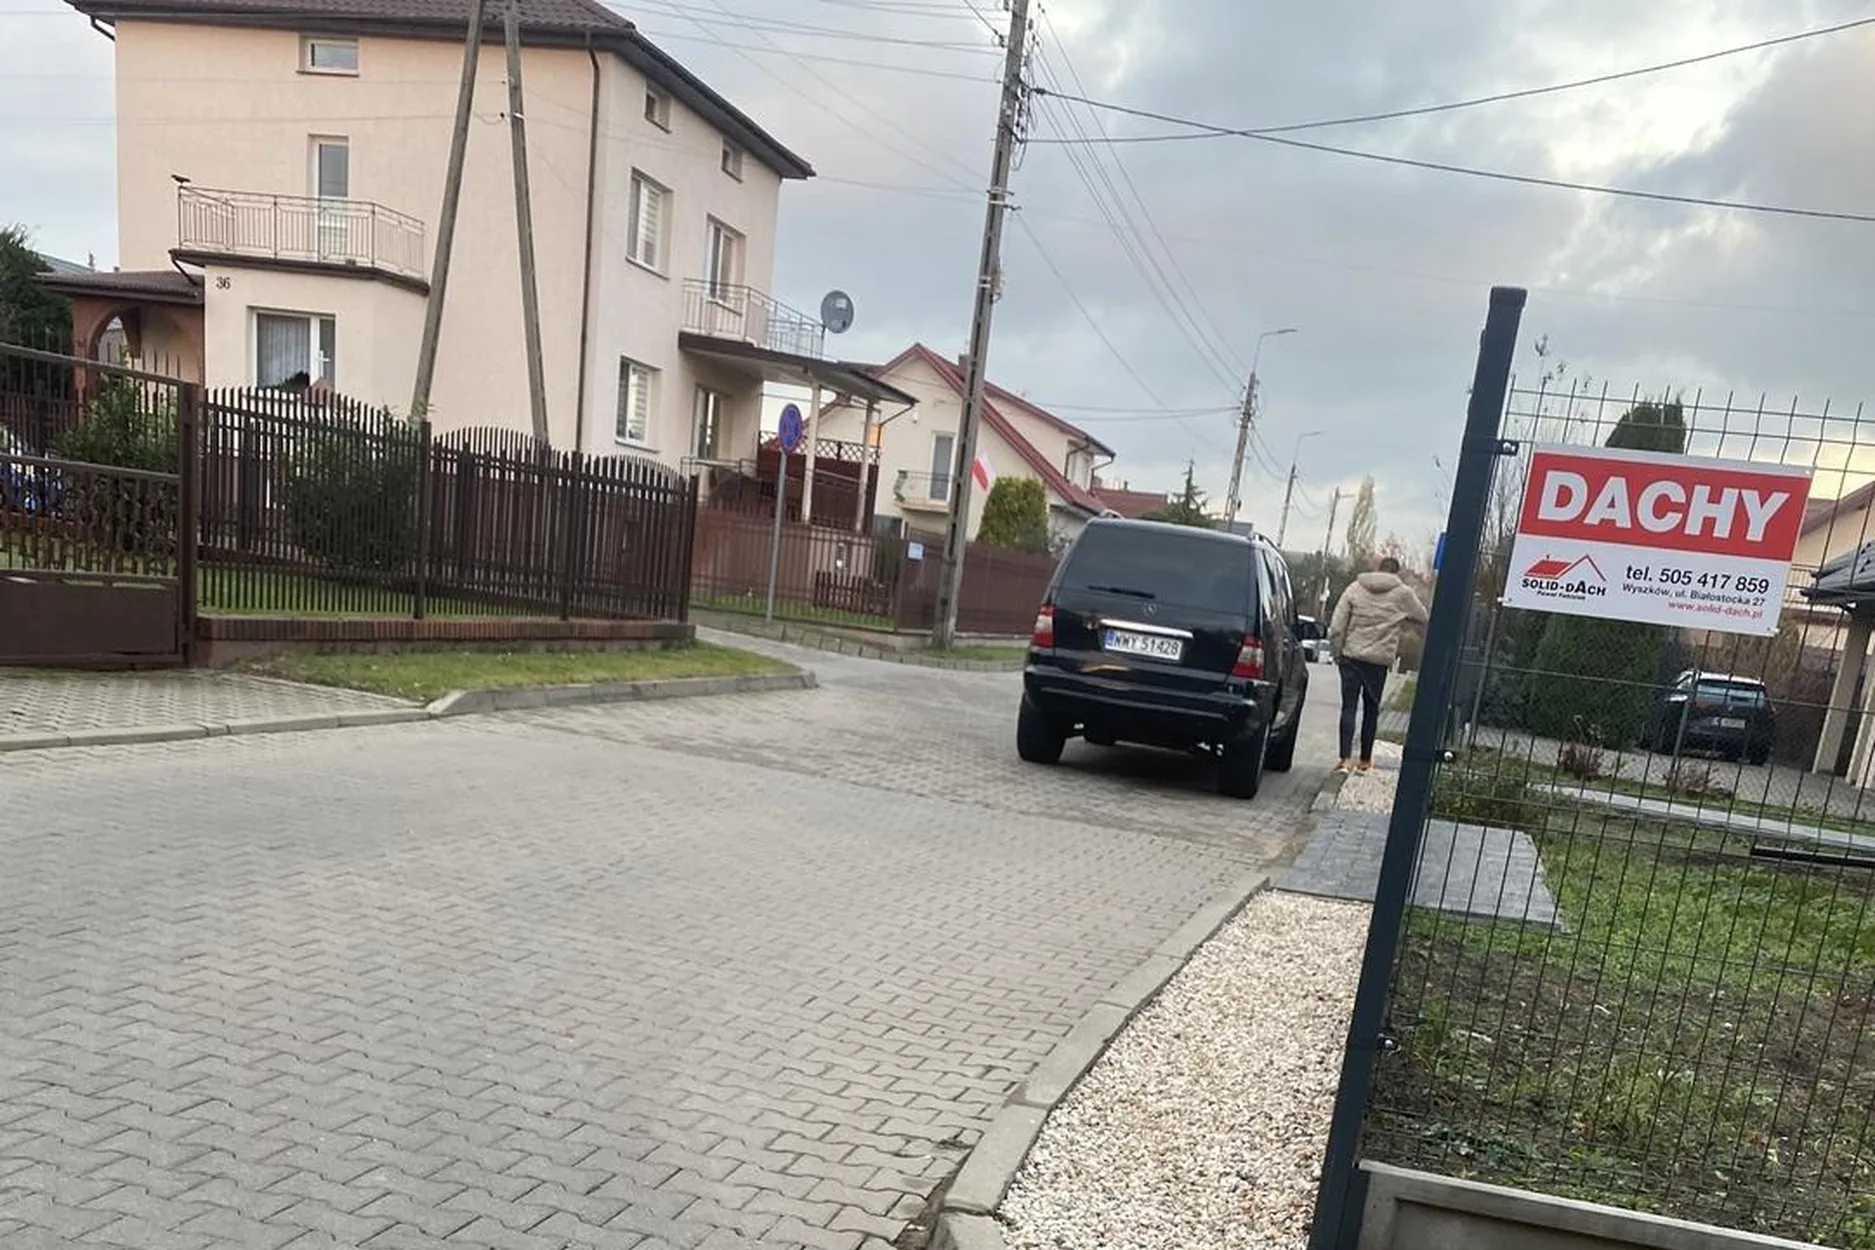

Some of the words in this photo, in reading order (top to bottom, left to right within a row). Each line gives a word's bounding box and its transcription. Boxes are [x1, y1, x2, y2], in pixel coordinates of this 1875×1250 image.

[216, 276, 231, 290] 36
[1537, 470, 1790, 541] DACHY
[1626, 565, 1652, 582] tel.
[1659, 568, 1692, 585] 505
[1697, 573, 1731, 589] 417
[1735, 576, 1770, 594] 859
[1622, 583, 1672, 598] Wyszków,
[1675, 590, 1687, 599] ul.
[1690, 590, 1751, 604] Białostocka
[1752, 598, 1765, 607] 27
[1668, 601, 1763, 619] www.solid-dach.pl
[1140, 637, 1180, 656] 51428
